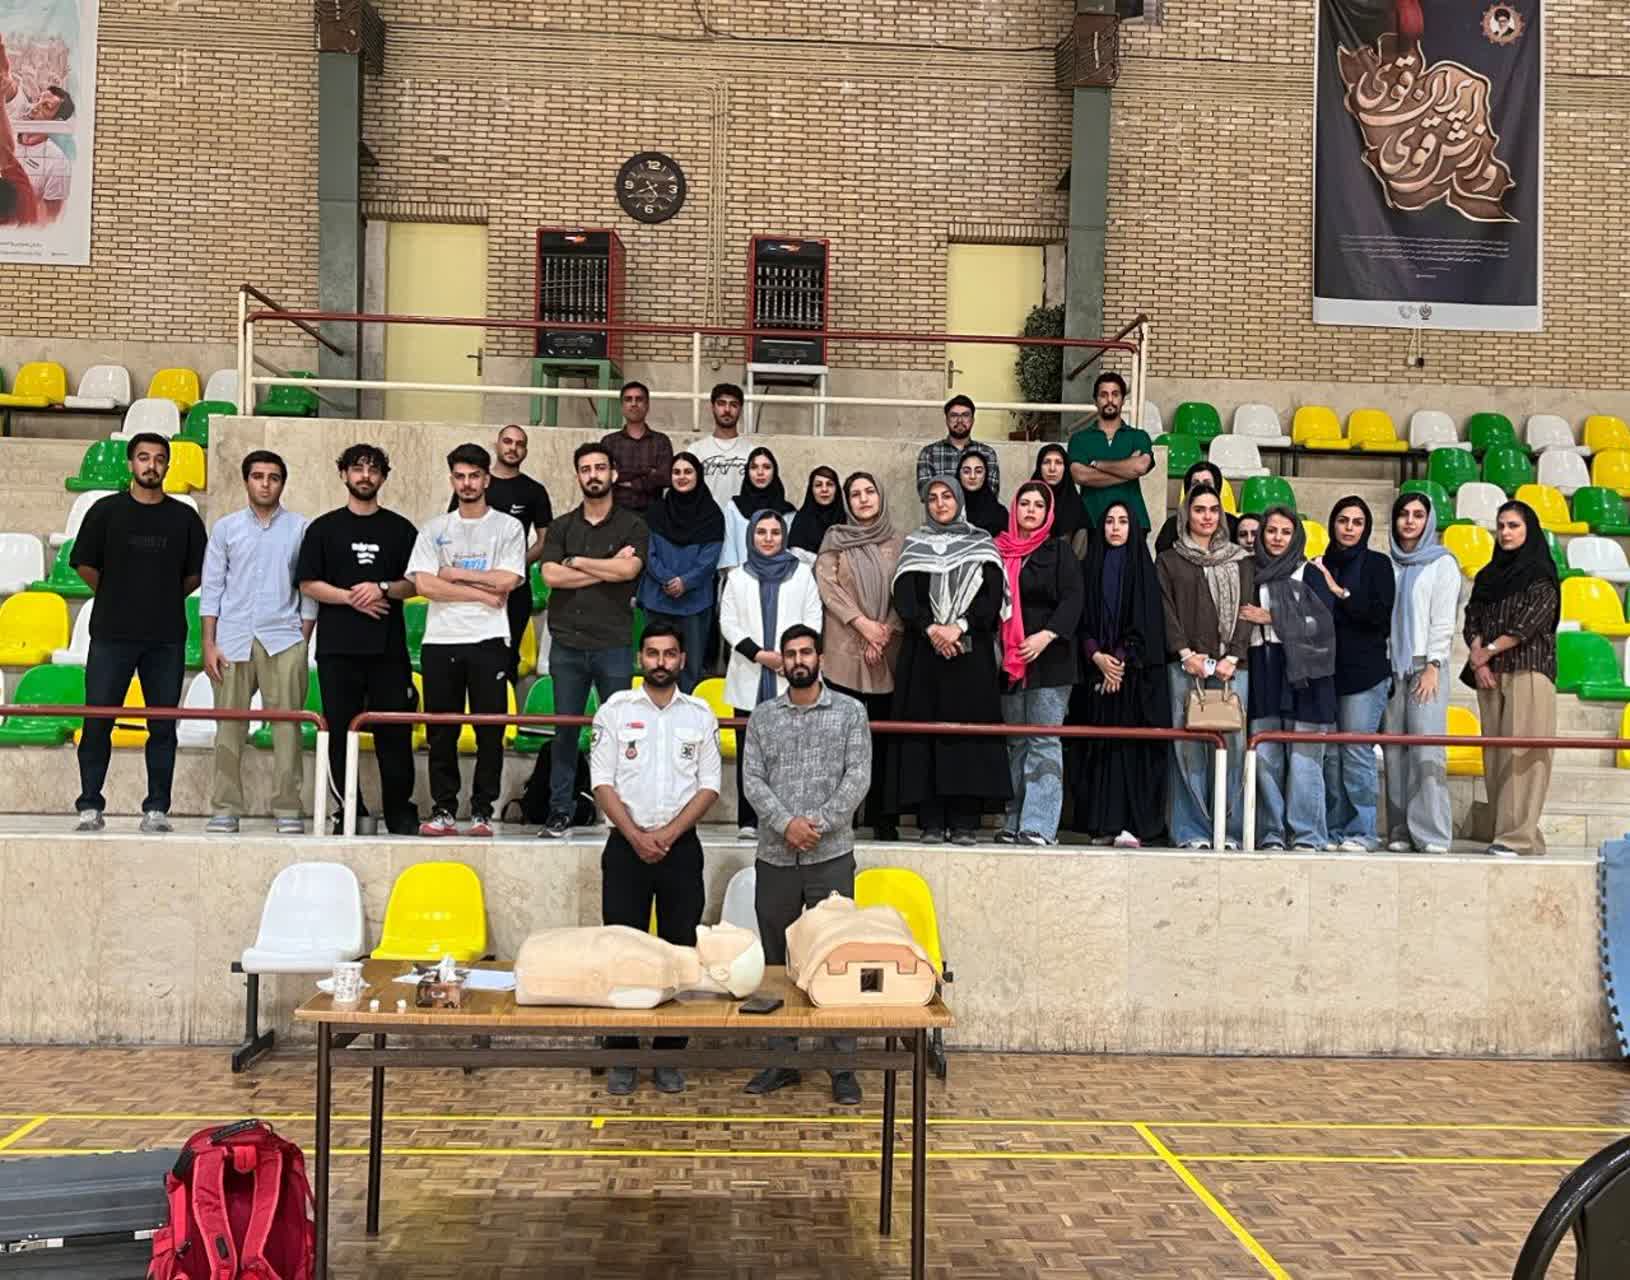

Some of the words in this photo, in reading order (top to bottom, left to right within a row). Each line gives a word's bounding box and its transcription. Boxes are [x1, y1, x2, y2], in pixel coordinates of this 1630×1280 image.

[1357, 55, 1416, 112] قوی
[1359, 66, 1479, 126] ایران
[1380, 116, 1441, 178] قوی
[1389, 121, 1498, 193] ورزش
[646, 160, 661, 170] 12
[624, 180, 634, 190] 9
[668, 185, 678, 194] 3
[644, 204, 654, 214] 6
